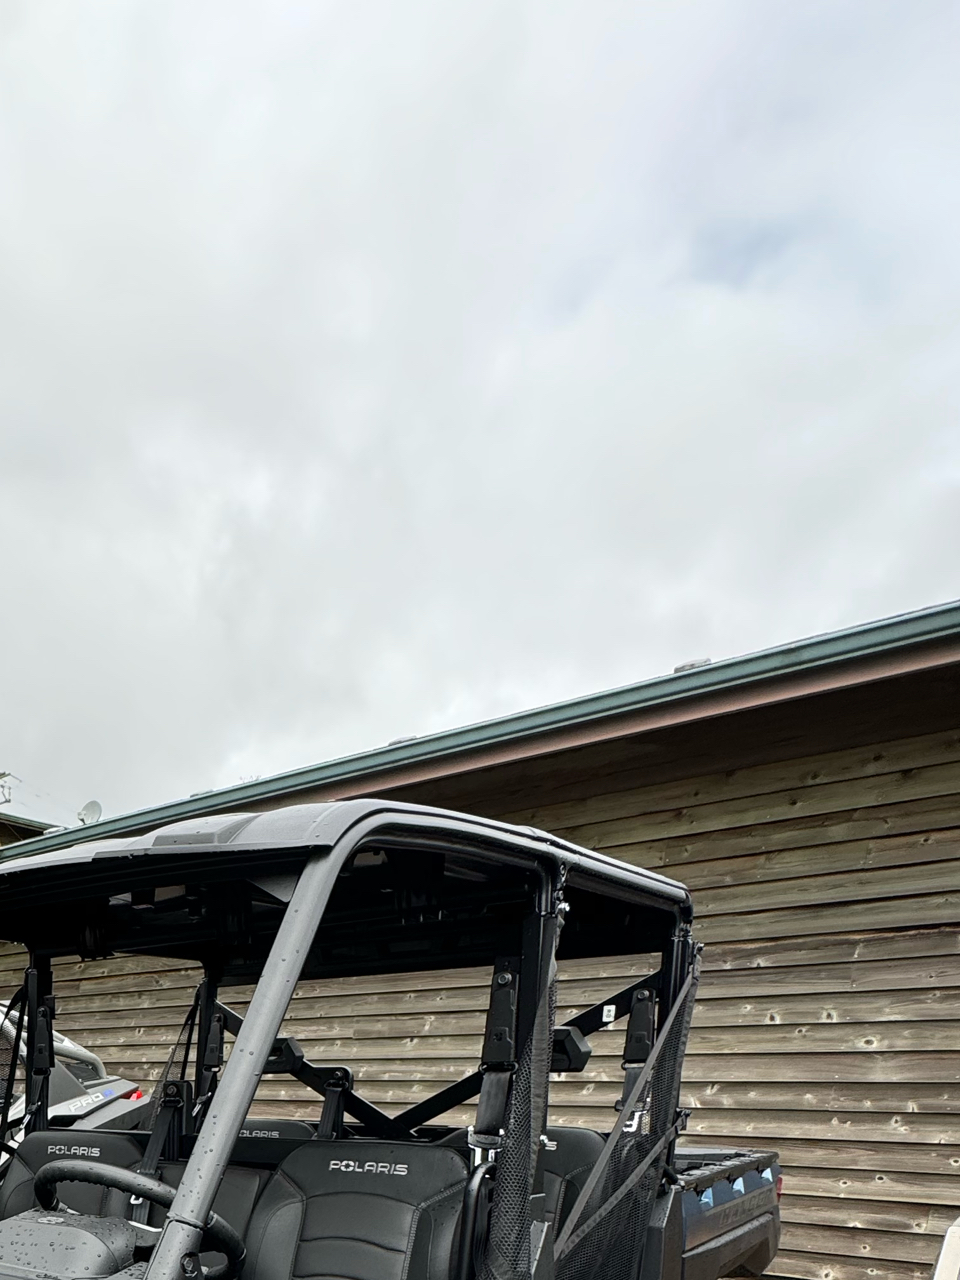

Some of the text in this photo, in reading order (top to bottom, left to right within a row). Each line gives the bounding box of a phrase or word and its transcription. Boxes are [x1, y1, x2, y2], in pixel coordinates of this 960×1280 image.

[239, 1129, 280, 1139] OLARIS
[47, 1145, 100, 1157] POLARIS
[329, 1160, 409, 1176] POLARIS
